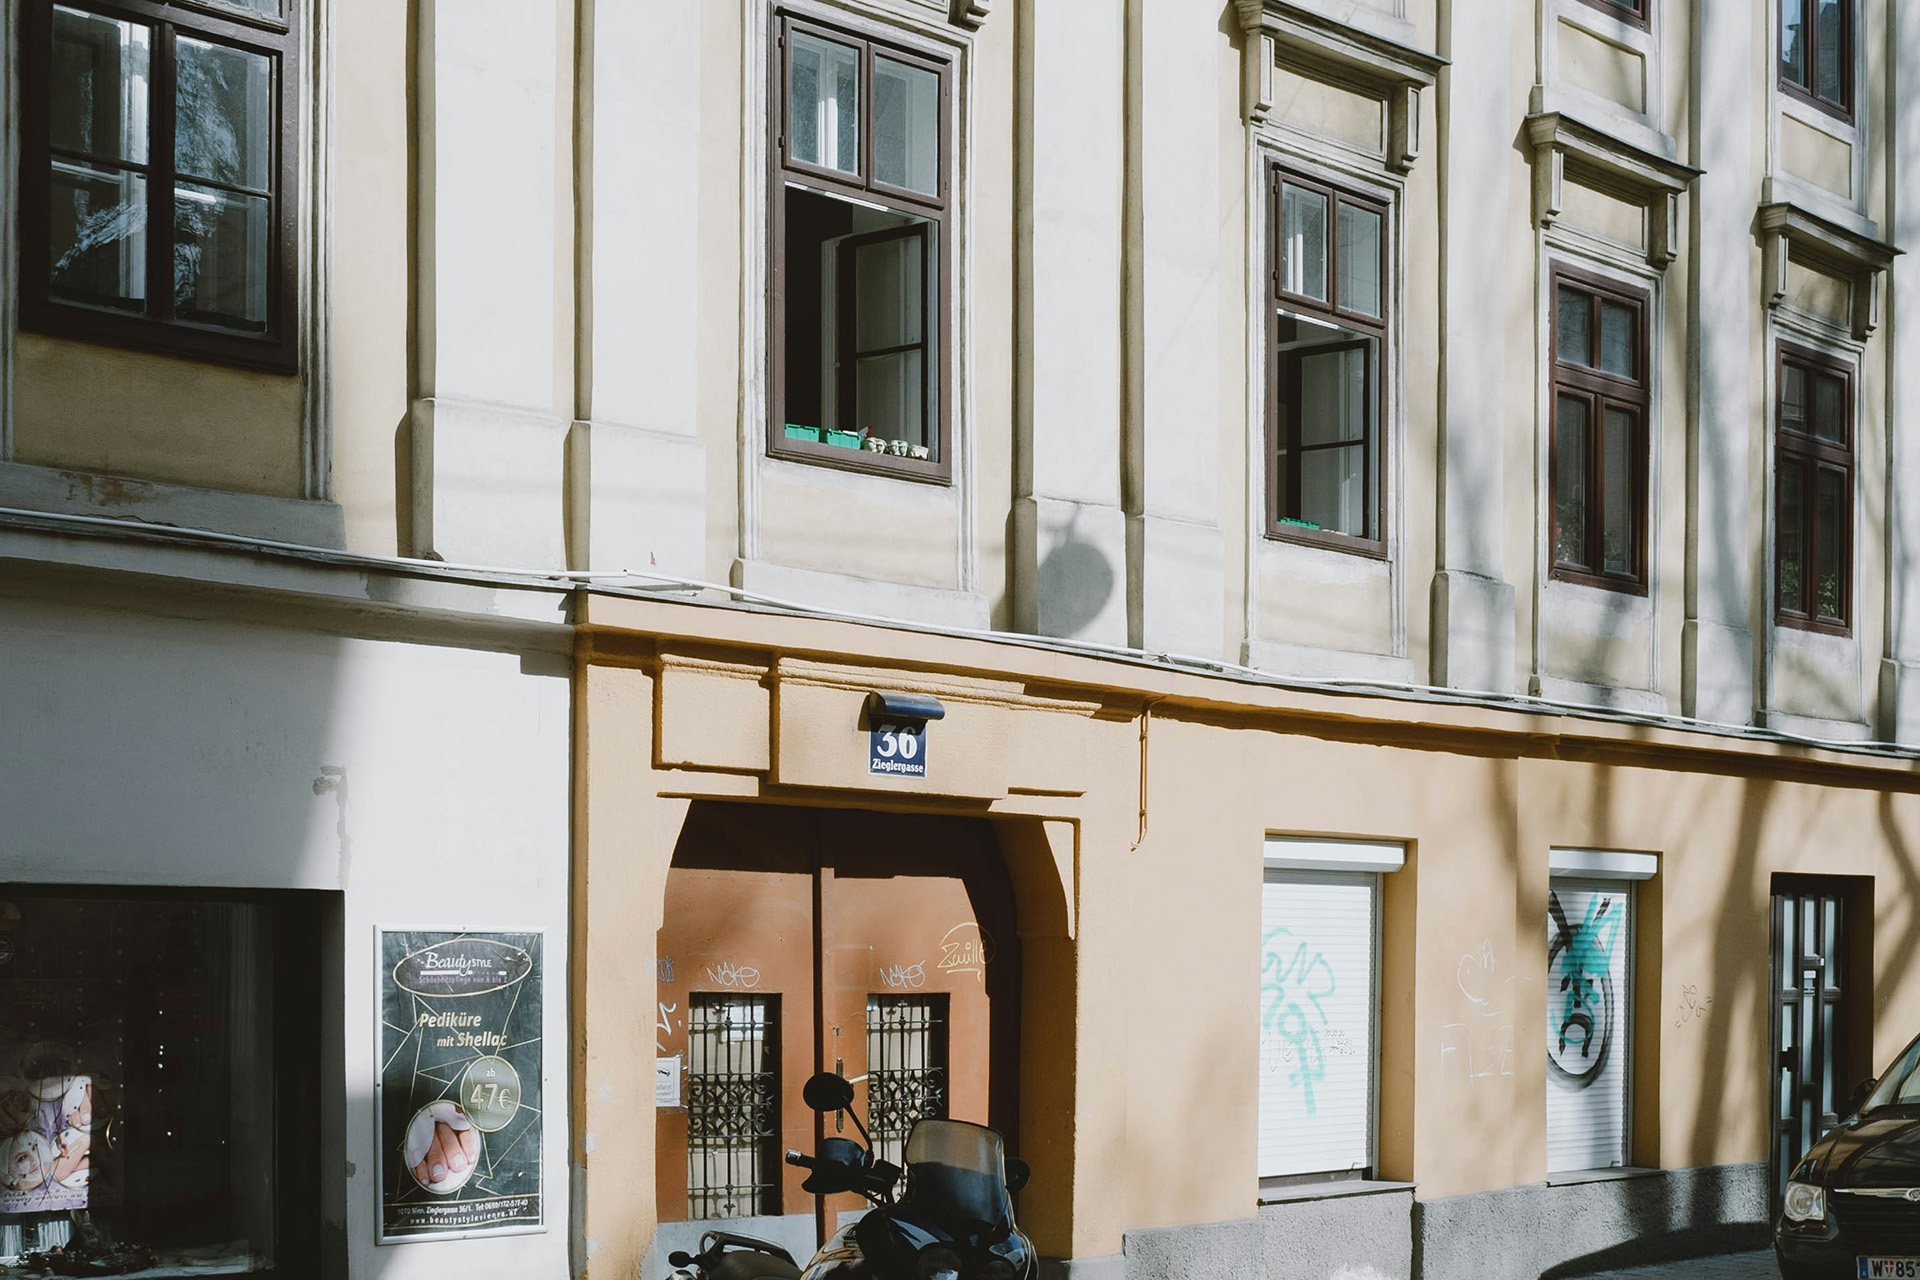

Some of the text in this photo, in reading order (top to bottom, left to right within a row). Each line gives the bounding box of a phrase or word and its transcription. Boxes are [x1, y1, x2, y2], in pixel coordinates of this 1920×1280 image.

[876, 724, 918, 759] 36
[872, 758, 924, 773] Zieglergasse
[419, 1012, 482, 1028] Pediküre
[436, 1030, 507, 1047] mit Shellac
[485, 1067, 496, 1078] ab
[470, 1083, 511, 1111] 47€
[1871, 1260, 1920, 1278] W 85
